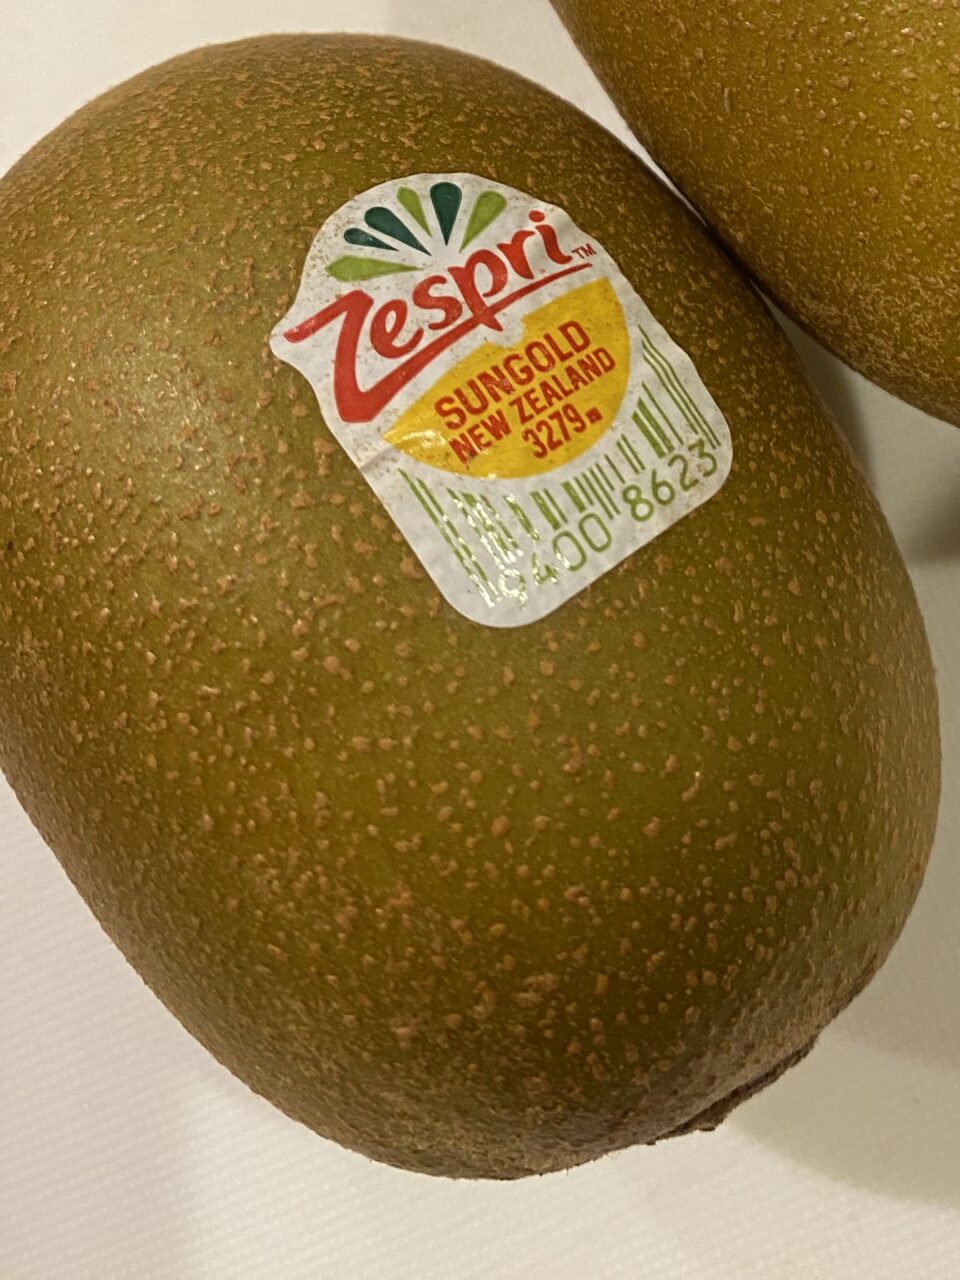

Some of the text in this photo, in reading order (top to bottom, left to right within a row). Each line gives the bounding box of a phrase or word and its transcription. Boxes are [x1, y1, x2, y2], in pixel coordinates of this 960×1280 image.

[283, 210, 592, 424] Zespri
[434, 320, 591, 430] SUNGOLD
[449, 347, 616, 465] NEW ZEALAND
[521, 403, 587, 459] 3279
[498, 438, 717, 609] 9400 8623
